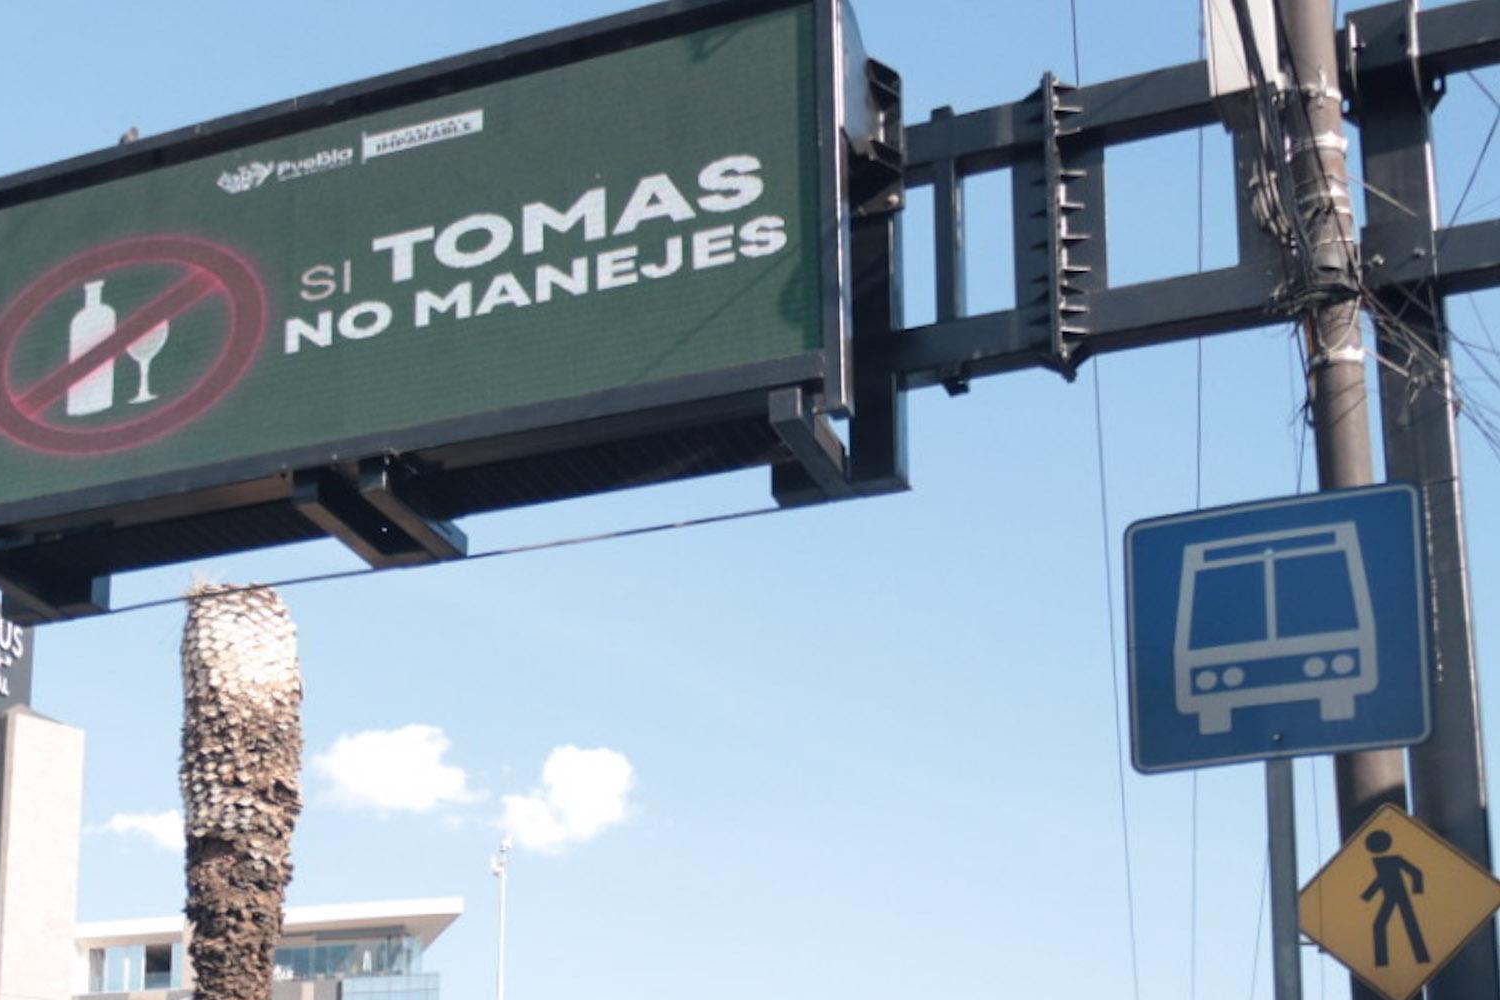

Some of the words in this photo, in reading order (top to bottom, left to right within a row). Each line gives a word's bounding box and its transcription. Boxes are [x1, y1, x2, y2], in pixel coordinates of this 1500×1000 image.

[276, 147, 354, 176] Puebla
[301, 260, 351, 301] SI
[372, 154, 765, 283] TOMAS
[284, 300, 393, 354] NO
[414, 215, 788, 328] MANEJES
